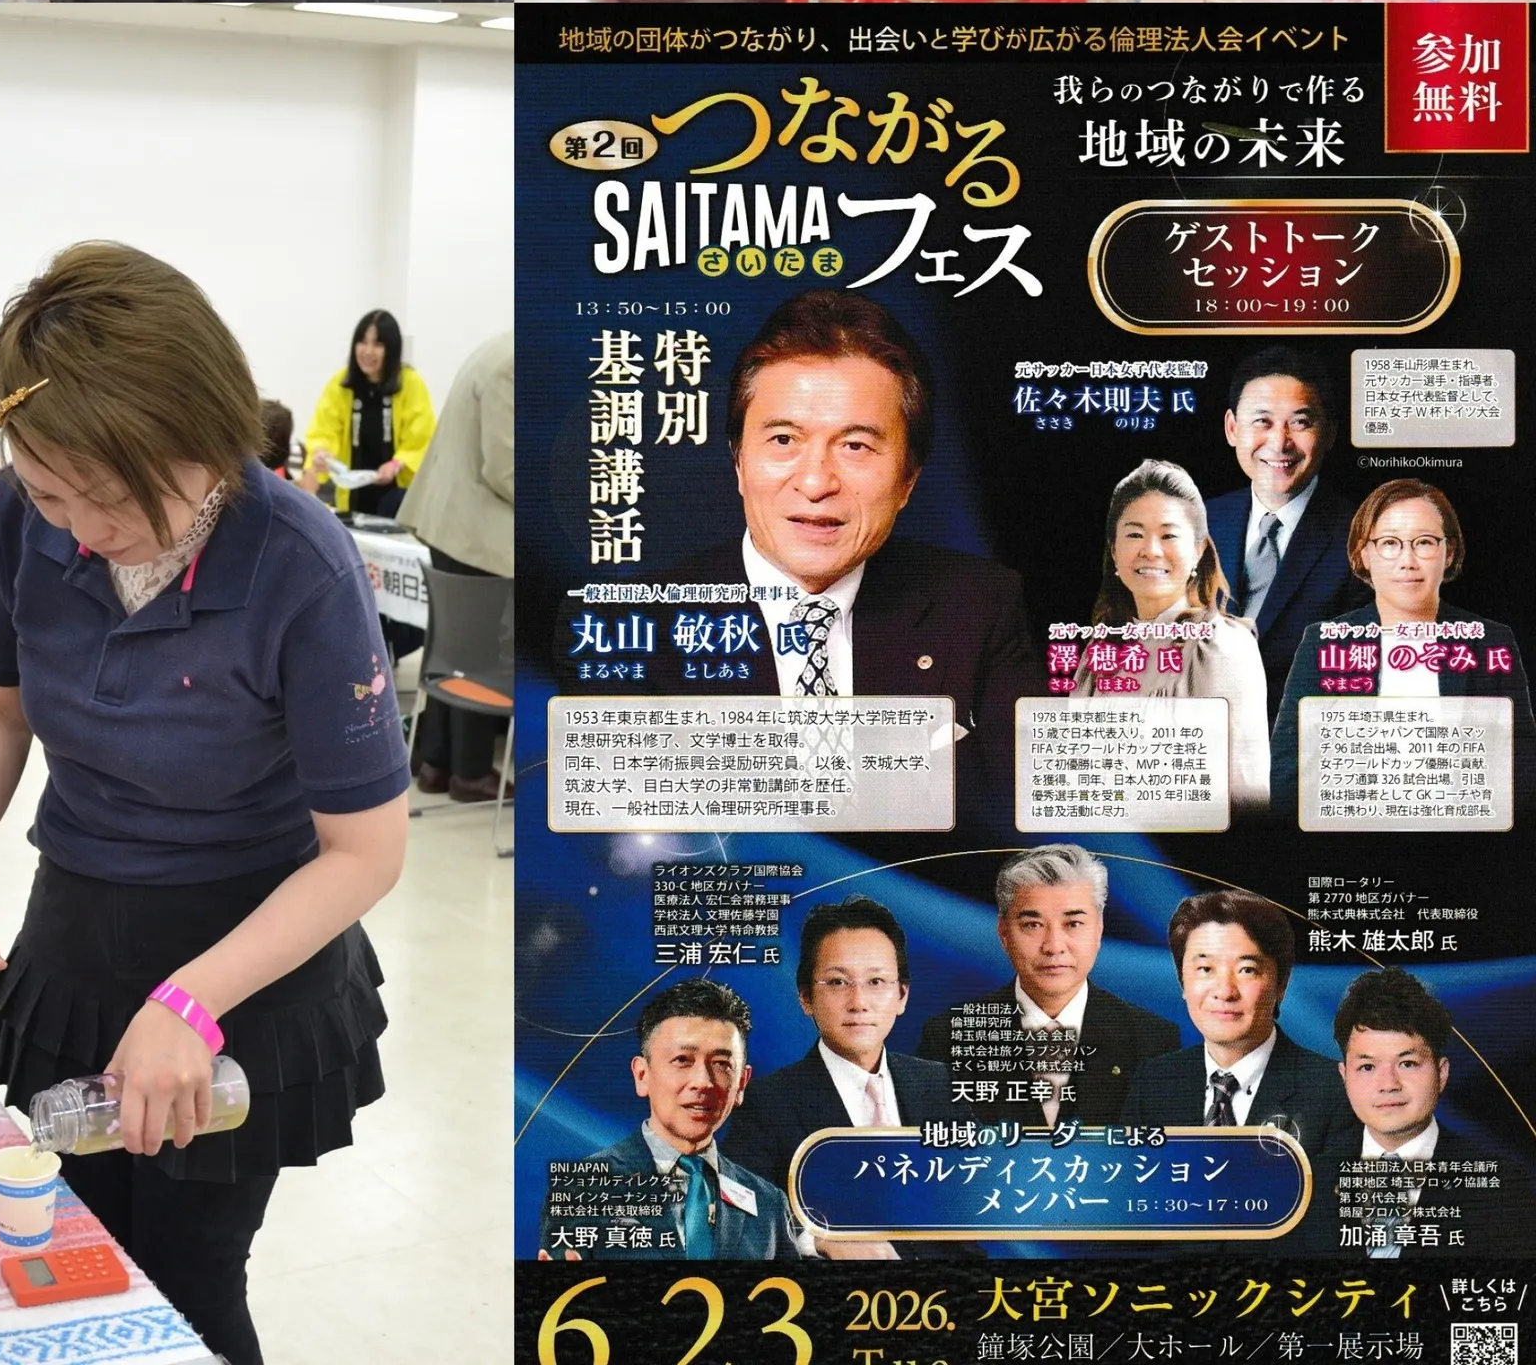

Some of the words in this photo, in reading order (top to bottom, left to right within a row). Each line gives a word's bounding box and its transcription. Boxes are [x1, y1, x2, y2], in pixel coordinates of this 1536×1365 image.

[558, 26, 1349, 54] 地域の団体がつながり、出会いと学びが広がる倫理法人会イベント
[1411, 33, 1501, 75] 参加
[1053, 75, 1365, 105] 我らのつながりで作る
[1411, 81, 1503, 123] 無料
[564, 130, 644, 161] 第2回
[651, 76, 1021, 208] つながる
[1078, 117, 1346, 168] 地域の未来
[594, 180, 831, 274] SAITAMA
[837, 191, 1044, 298] フェス
[1164, 221, 1380, 255] ゲストトーク
[700, 247, 841, 275] さいたま
[1182, 257, 1364, 289] セッション
[1015, 361, 1208, 379] 元サッカー日本女子代表監督
[1365, 359, 1479, 371] 1958年山形県生まれ。
[654, 329, 712, 446] 特別
[1365, 375, 1499, 387] 元サッカー選手・指導者。
[1013, 386, 1162, 413] 佐々木則夫
[1172, 390, 1194, 413] 氏
[1365, 391, 1498, 403] 日本女子代表監督として、
[1036, 417, 1074, 430] ささき
[1115, 417, 1156, 430] のりお
[1365, 422, 1393, 434] 優勝。
[588, 329, 645, 565] 基調講話
[568, 584, 747, 602] 一般社団法人倫理研究所
[750, 585, 800, 602] 理事長
[571, 614, 654, 655] 丸山
[672, 613, 761, 655] 敏秋
[777, 622, 808, 655] 氏
[1049, 623, 1212, 640] 元サッカー女子日本代表
[1321, 623, 1485, 639] 元サッカー女子日本代表
[1050, 645, 1078, 672] 澤
[1089, 644, 1147, 672] 穂希
[1158, 649, 1182, 671] 氏
[1320, 644, 1377, 672] 山郷
[1389, 644, 1477, 672] のぞみ
[1488, 648, 1512, 671] 氏
[577, 662, 646, 680] まるやま
[683, 662, 751, 680] としあき
[1048, 678, 1076, 691] さわ
[1098, 678, 1139, 691] ほまれ
[1321, 677, 1375, 692] やまごう
[1032, 712, 1146, 724] 1978年東京都生まれ。
[1320, 711, 1435, 723] 1975年埼玉県生まれ。
[564, 732, 805, 749] 思想研究科修了、文学博士を取得。
[1320, 758, 1489, 770] 女子ワールドカップ優勝に貢献。
[564, 778, 854, 794] 筑波大学、目白大学の非常勤講師を歴任。
[564, 800, 838, 817] 現在、一般社団法人倫理研究所理事長。
[1032, 805, 1130, 817] は普及活動に尽力。
[1319, 805, 1496, 817] 成に携わり、現在は強化育成部長。
[654, 865, 803, 877] ライオンズクラブ国際協会
[1308, 877, 1395, 888] 国際ロータリー
[654, 894, 702, 906] 医療法人
[705, 894, 791, 906] 宏仁会常務理事
[654, 909, 703, 921] 学校法人
[706, 909, 779, 921] 文理佐藤学園
[1307, 908, 1406, 920] 熊木式典株式会社
[1417, 908, 1479, 920] 代表取締役
[654, 924, 728, 936] 西武文理大学
[730, 924, 779, 936] 特命教授
[1308, 930, 1356, 952] 熊木
[1362, 930, 1434, 952] 雄太郎
[1440, 934, 1458, 952] 氏
[655, 942, 702, 965] 三浦
[709, 942, 757, 965] 宏仁
[762, 947, 780, 964] 氏
[950, 1003, 1024, 1015] 一般社団法人
[950, 1017, 1012, 1028] 倫理研究所
[950, 1030, 1048, 1042] 埼玉県倫理法人会
[950, 1045, 1097, 1057] 株式会社旅クラブジャパン
[950, 1060, 1086, 1072] さくら観光バス株式会社
[951, 1080, 1000, 1103] 天野
[1005, 1080, 1053, 1103] 正幸
[1059, 1086, 1077, 1102] 氏
[922, 1121, 1166, 1148] 地域のリーダーによる
[571, 1162, 609, 1173] JAPAN
[853, 1154, 1230, 1185] パネルディスカッション
[1339, 1160, 1499, 1174] 公益社団法人日本青年会議所
[550, 1175, 684, 1187] ナショナルディレクター
[1339, 1176, 1388, 1189] 関東地区
[1391, 1176, 1501, 1189] 埼玉ブロック協議会
[976, 1188, 1110, 1216] メンバー
[550, 1205, 600, 1217] 株式会社
[601, 1205, 663, 1217] 代表取締役
[1339, 1206, 1462, 1219] 鍋屋プロパン株式会社
[550, 1226, 598, 1249] 大野
[605, 1226, 653, 1249] 真徳
[659, 1232, 676, 1248] 氏
[1339, 1224, 1387, 1247] 加涌
[1393, 1224, 1442, 1247] 章吾
[1448, 1229, 1465, 1247] 氏
[1451, 1278, 1516, 1295] 詳しくは
[976, 1276, 1417, 1323] 大宮ソニックシティ
[1461, 1296, 1507, 1312] こちら
